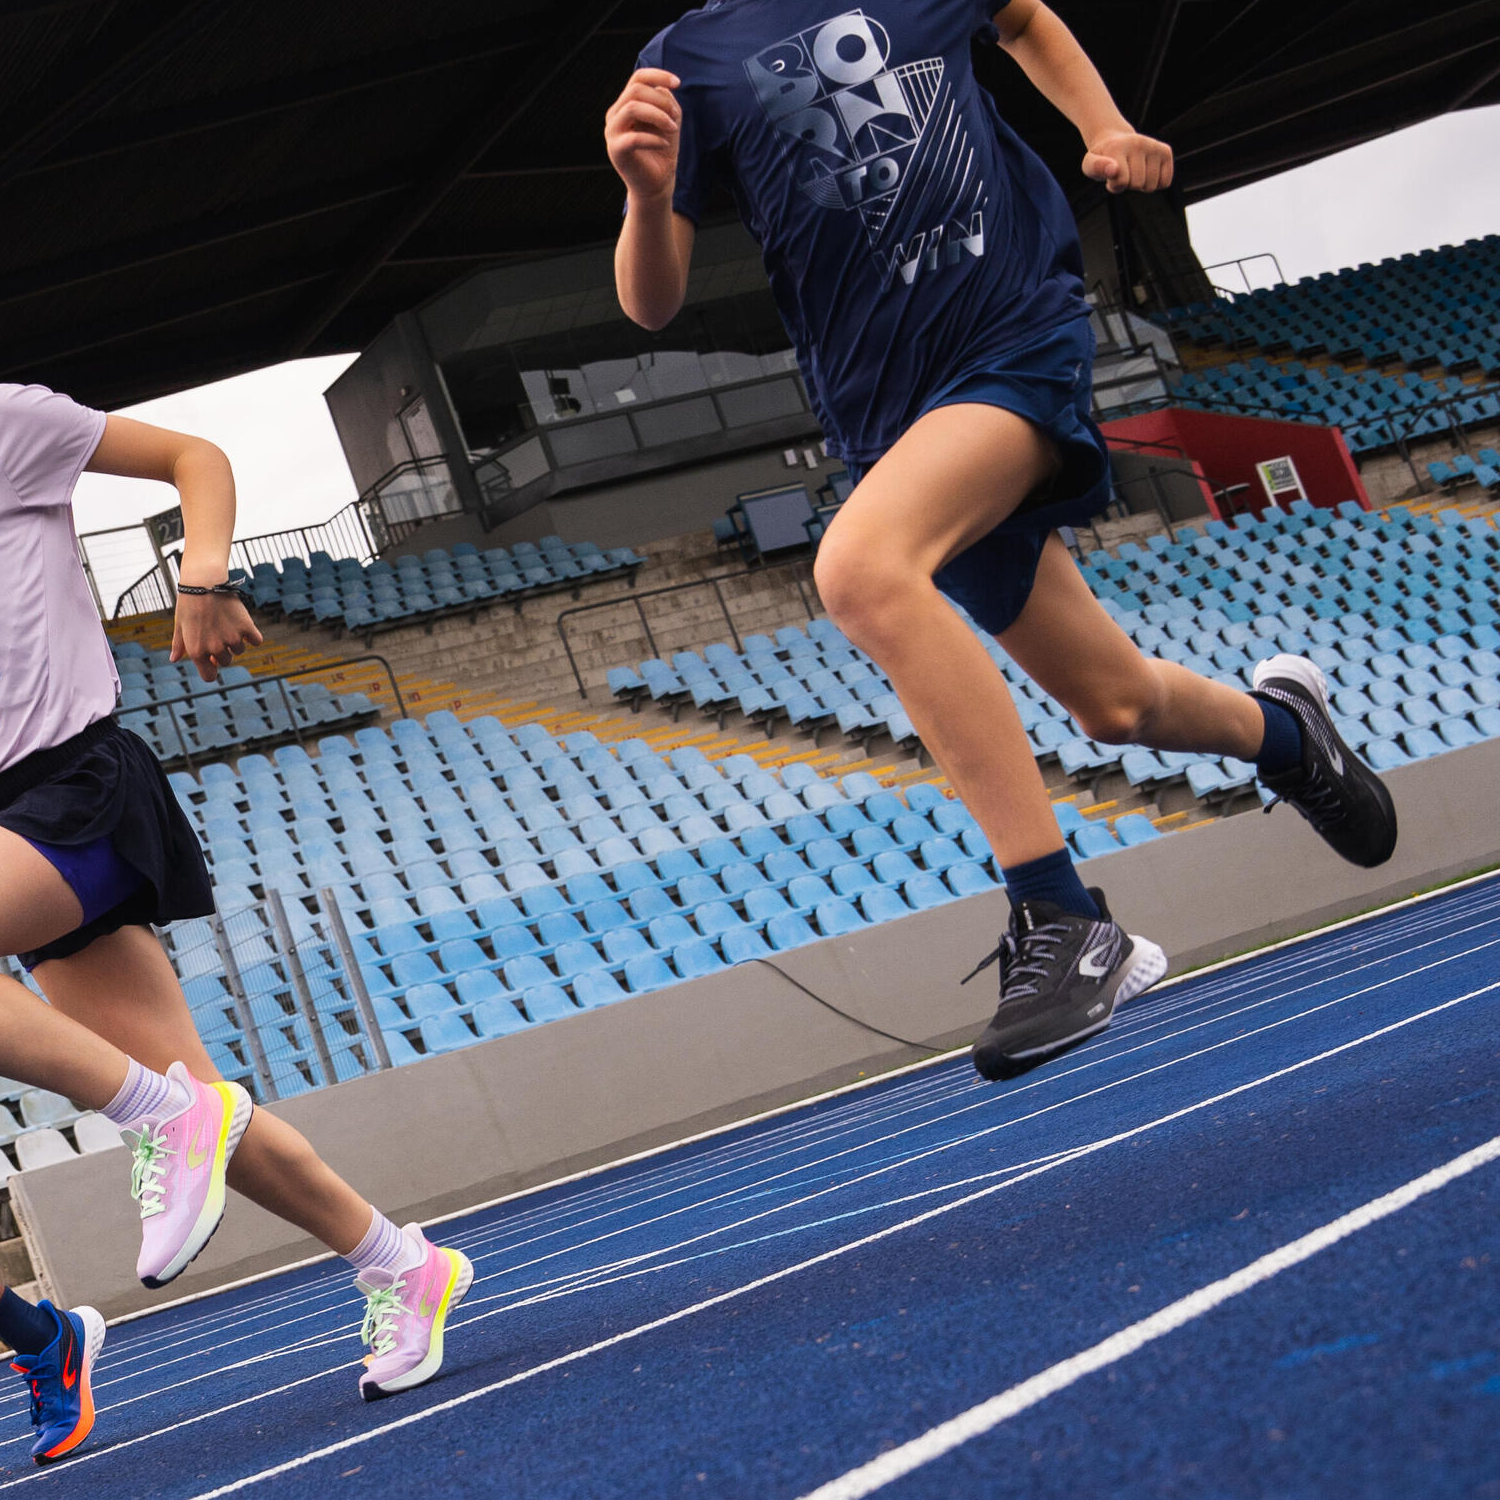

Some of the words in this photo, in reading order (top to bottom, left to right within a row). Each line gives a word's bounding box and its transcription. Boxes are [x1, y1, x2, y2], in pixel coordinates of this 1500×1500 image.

[843, 156, 900, 204] TO
[870, 210, 985, 294] WIN
[158, 516, 182, 542] 27
